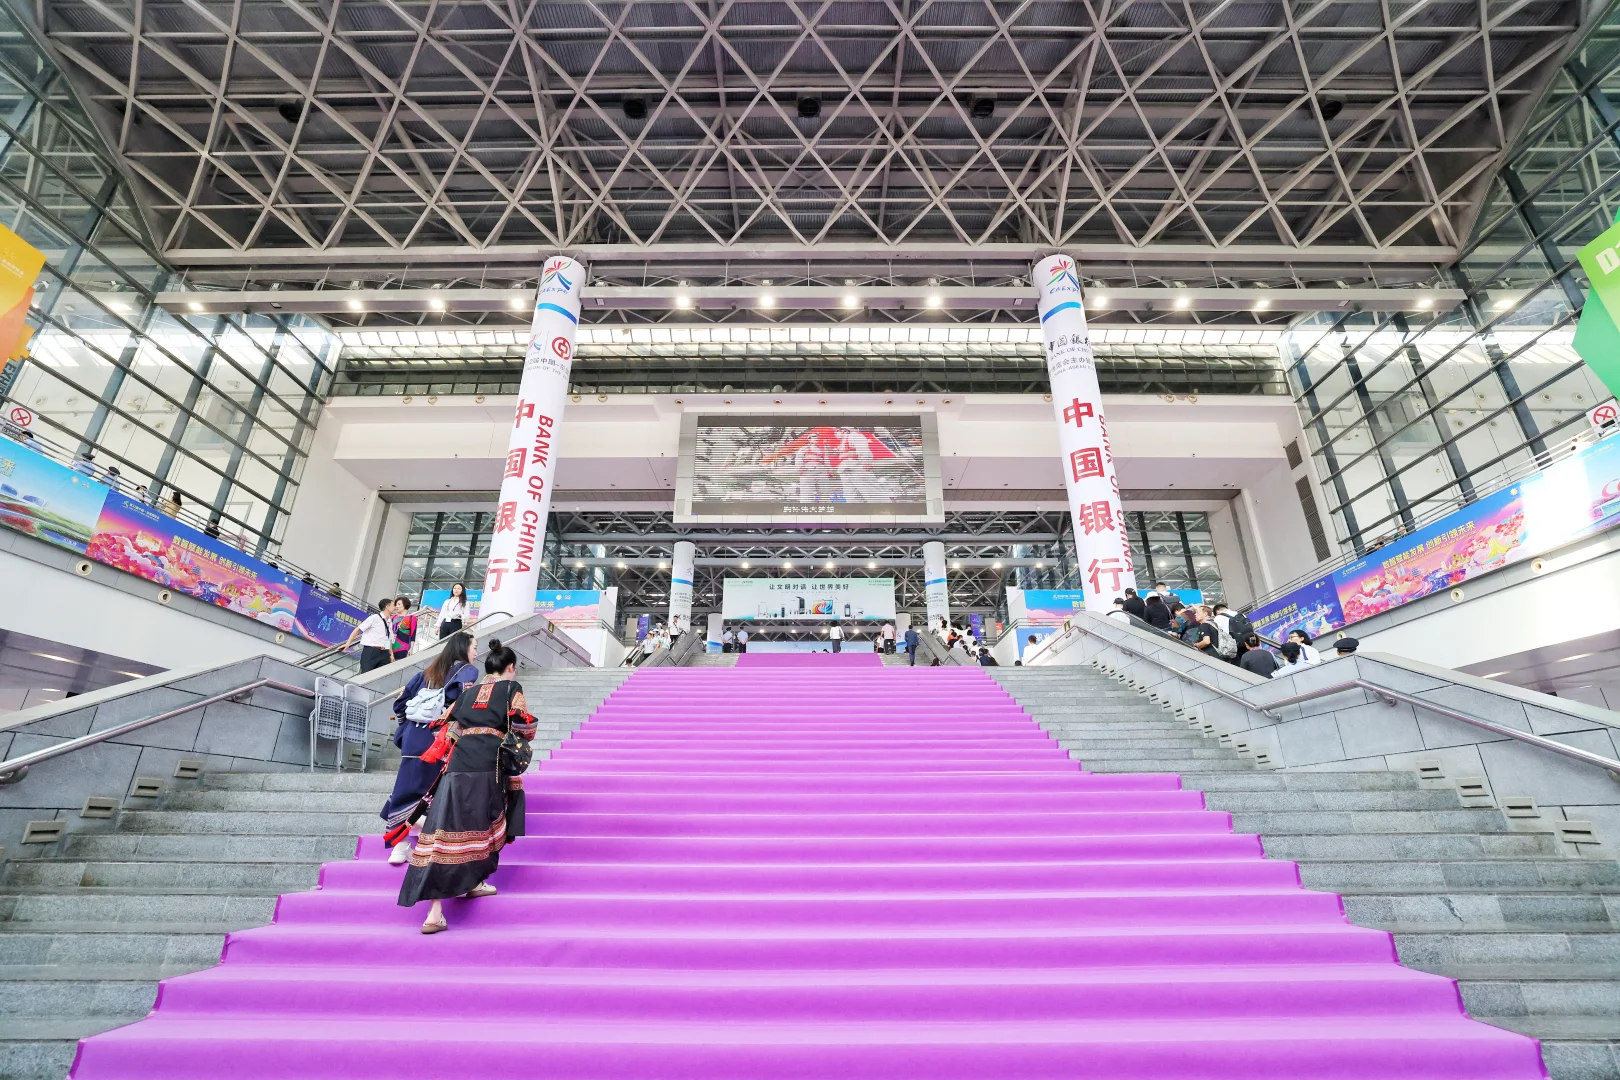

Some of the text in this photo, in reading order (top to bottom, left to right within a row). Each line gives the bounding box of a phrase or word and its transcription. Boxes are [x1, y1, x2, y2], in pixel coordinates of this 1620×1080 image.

[1596, 238, 1620, 275] D
[514, 414, 554, 573] BANK OF CHINA
[1063, 397, 1123, 594] 中国银行
[768, 583, 850, 591] 让文明对话 让世界美好
